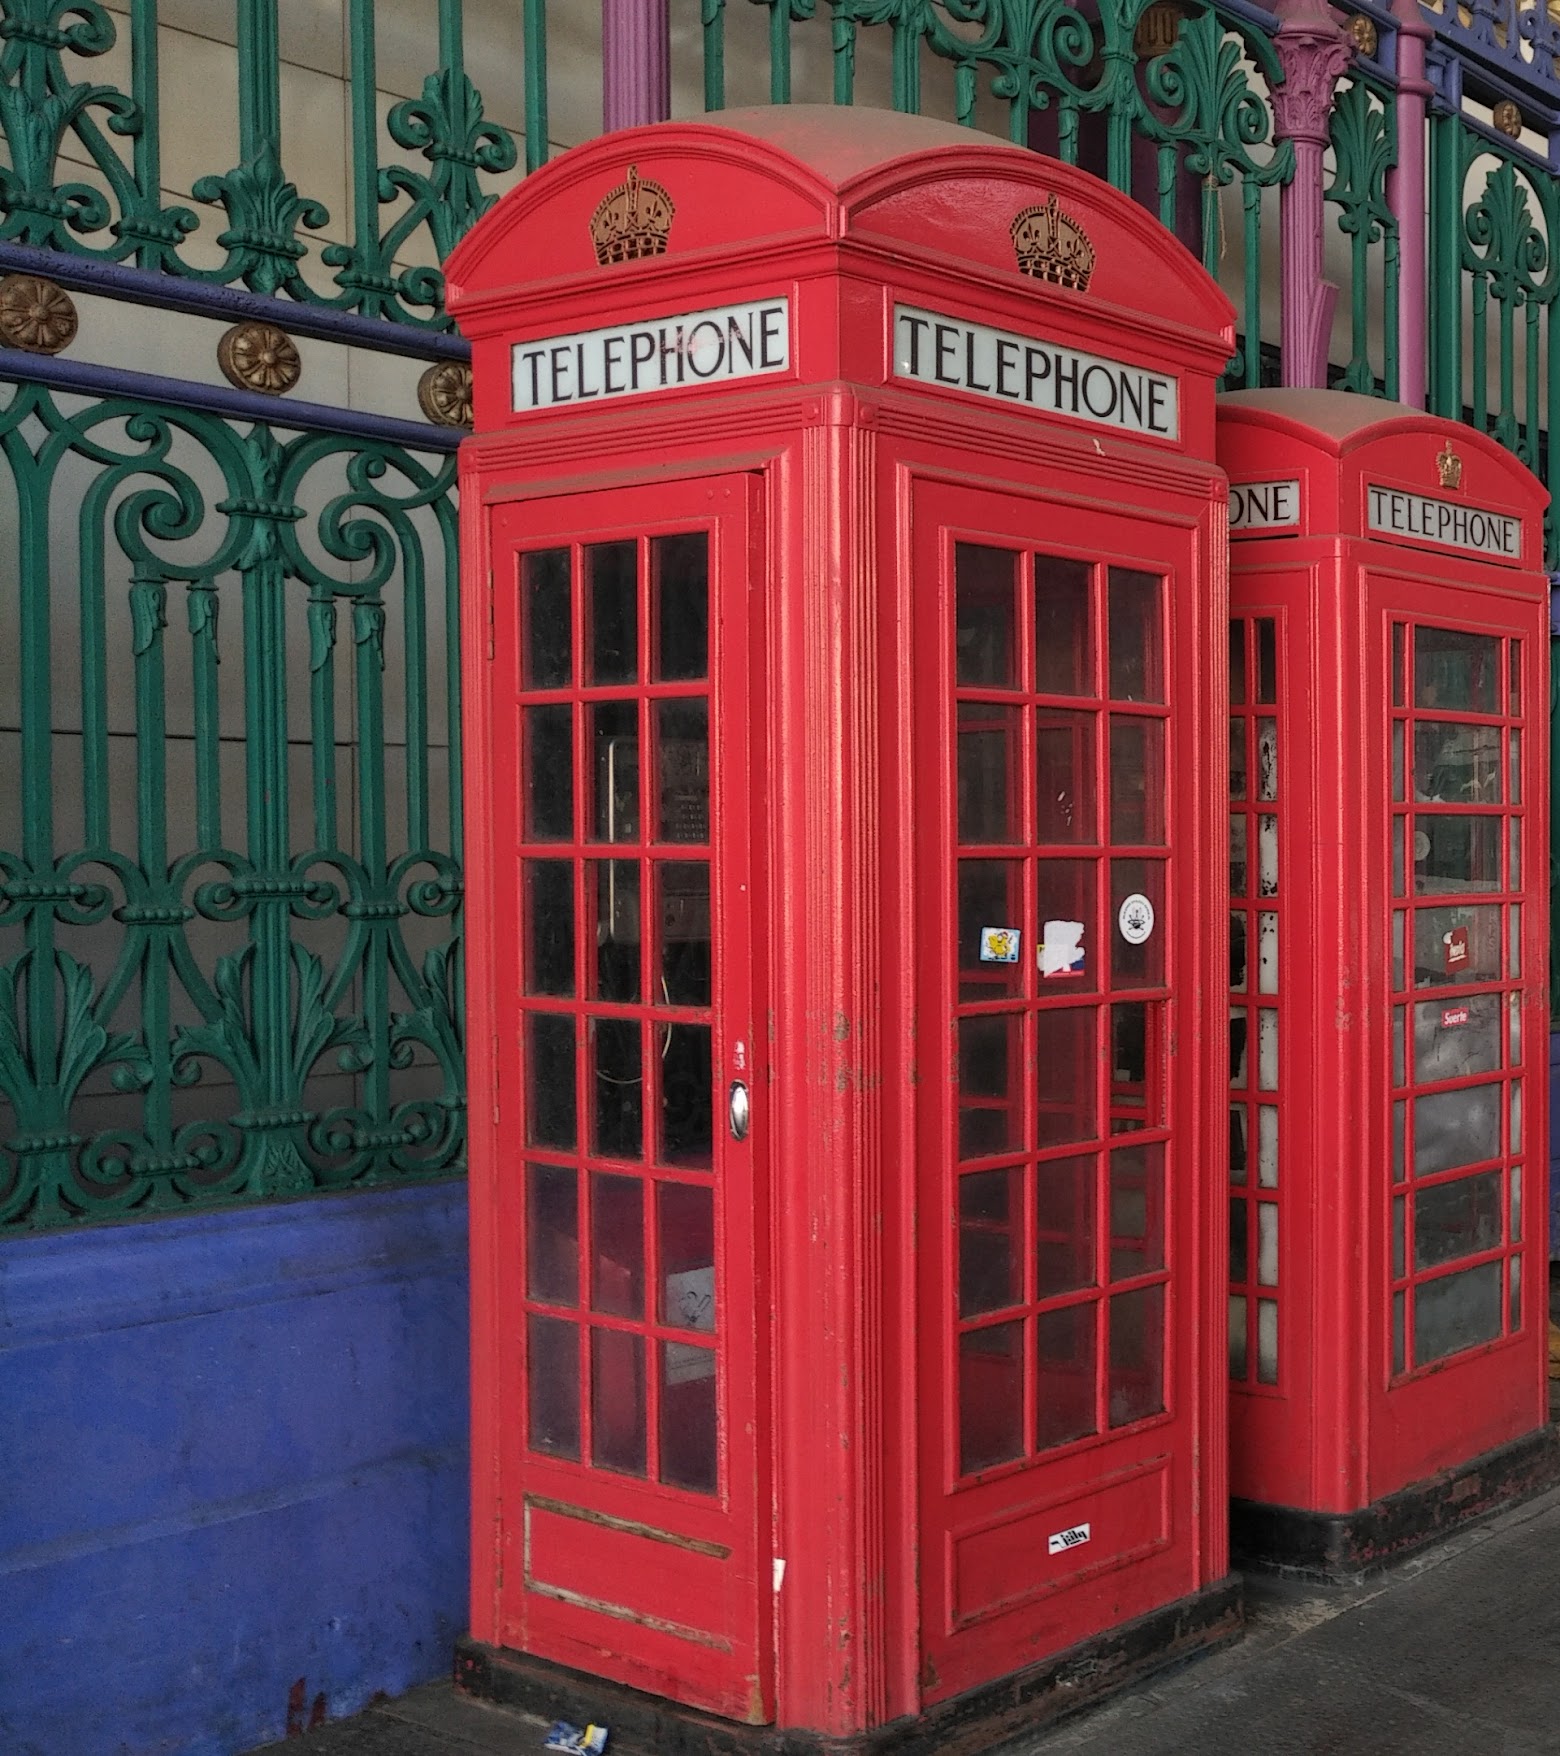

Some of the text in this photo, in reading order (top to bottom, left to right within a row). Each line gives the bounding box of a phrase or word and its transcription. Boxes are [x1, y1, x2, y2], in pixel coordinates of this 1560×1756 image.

[522, 307, 785, 406] TELEPHONE
[899, 315, 1169, 433] TELEPHONE
[1370, 489, 1515, 554] TELEPHONE
